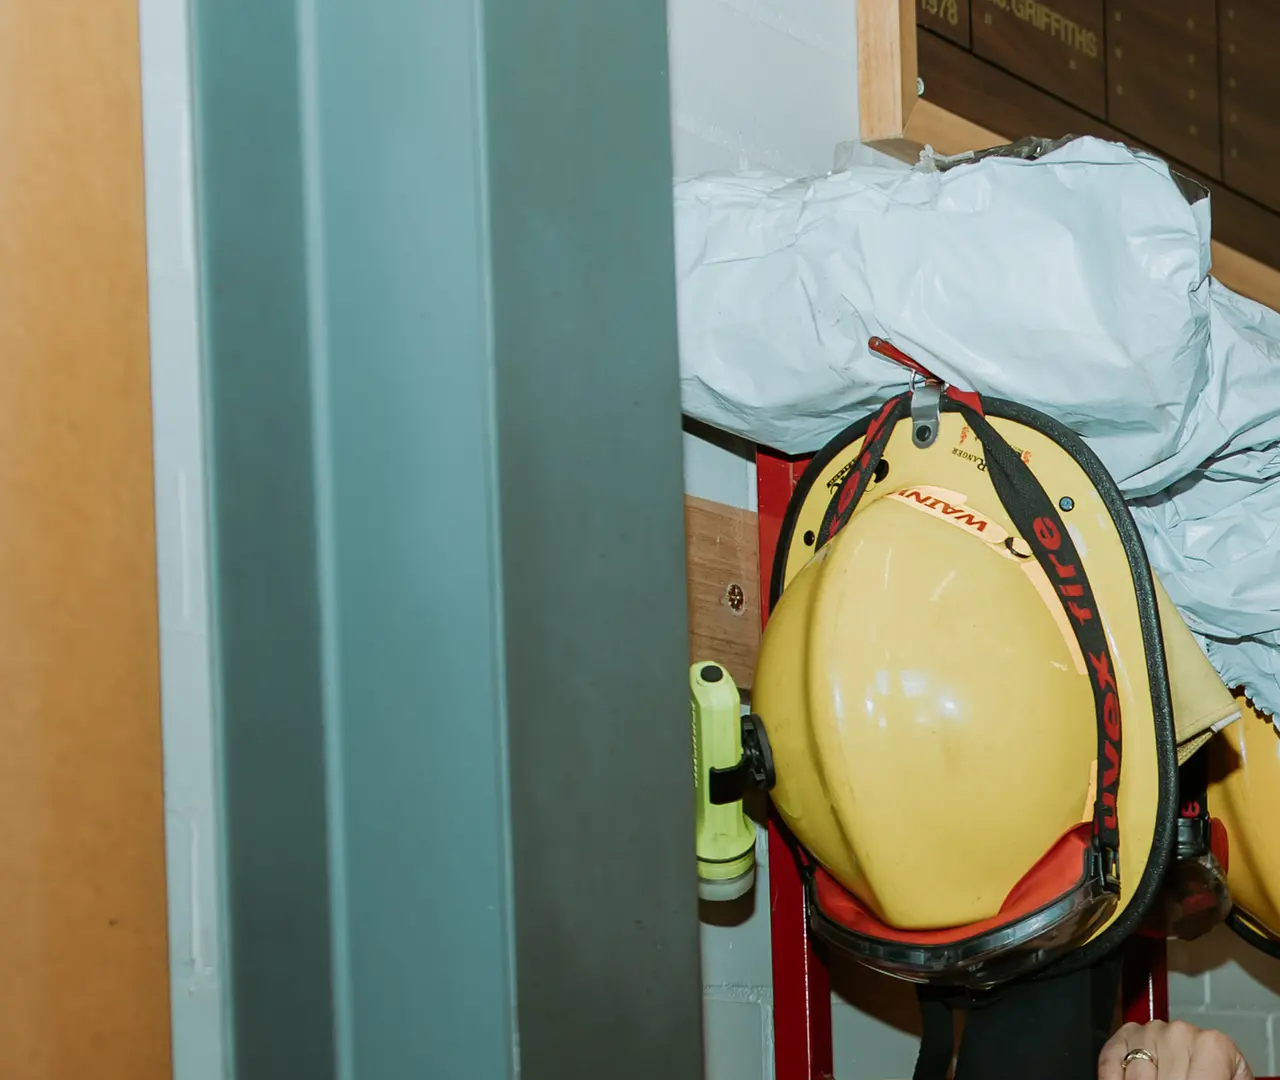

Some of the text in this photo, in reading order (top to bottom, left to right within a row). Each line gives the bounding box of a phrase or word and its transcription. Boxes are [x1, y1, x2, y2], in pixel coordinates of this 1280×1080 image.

[952, 447, 987, 472] RANGER
[1034, 515, 1122, 827] uvex fire
